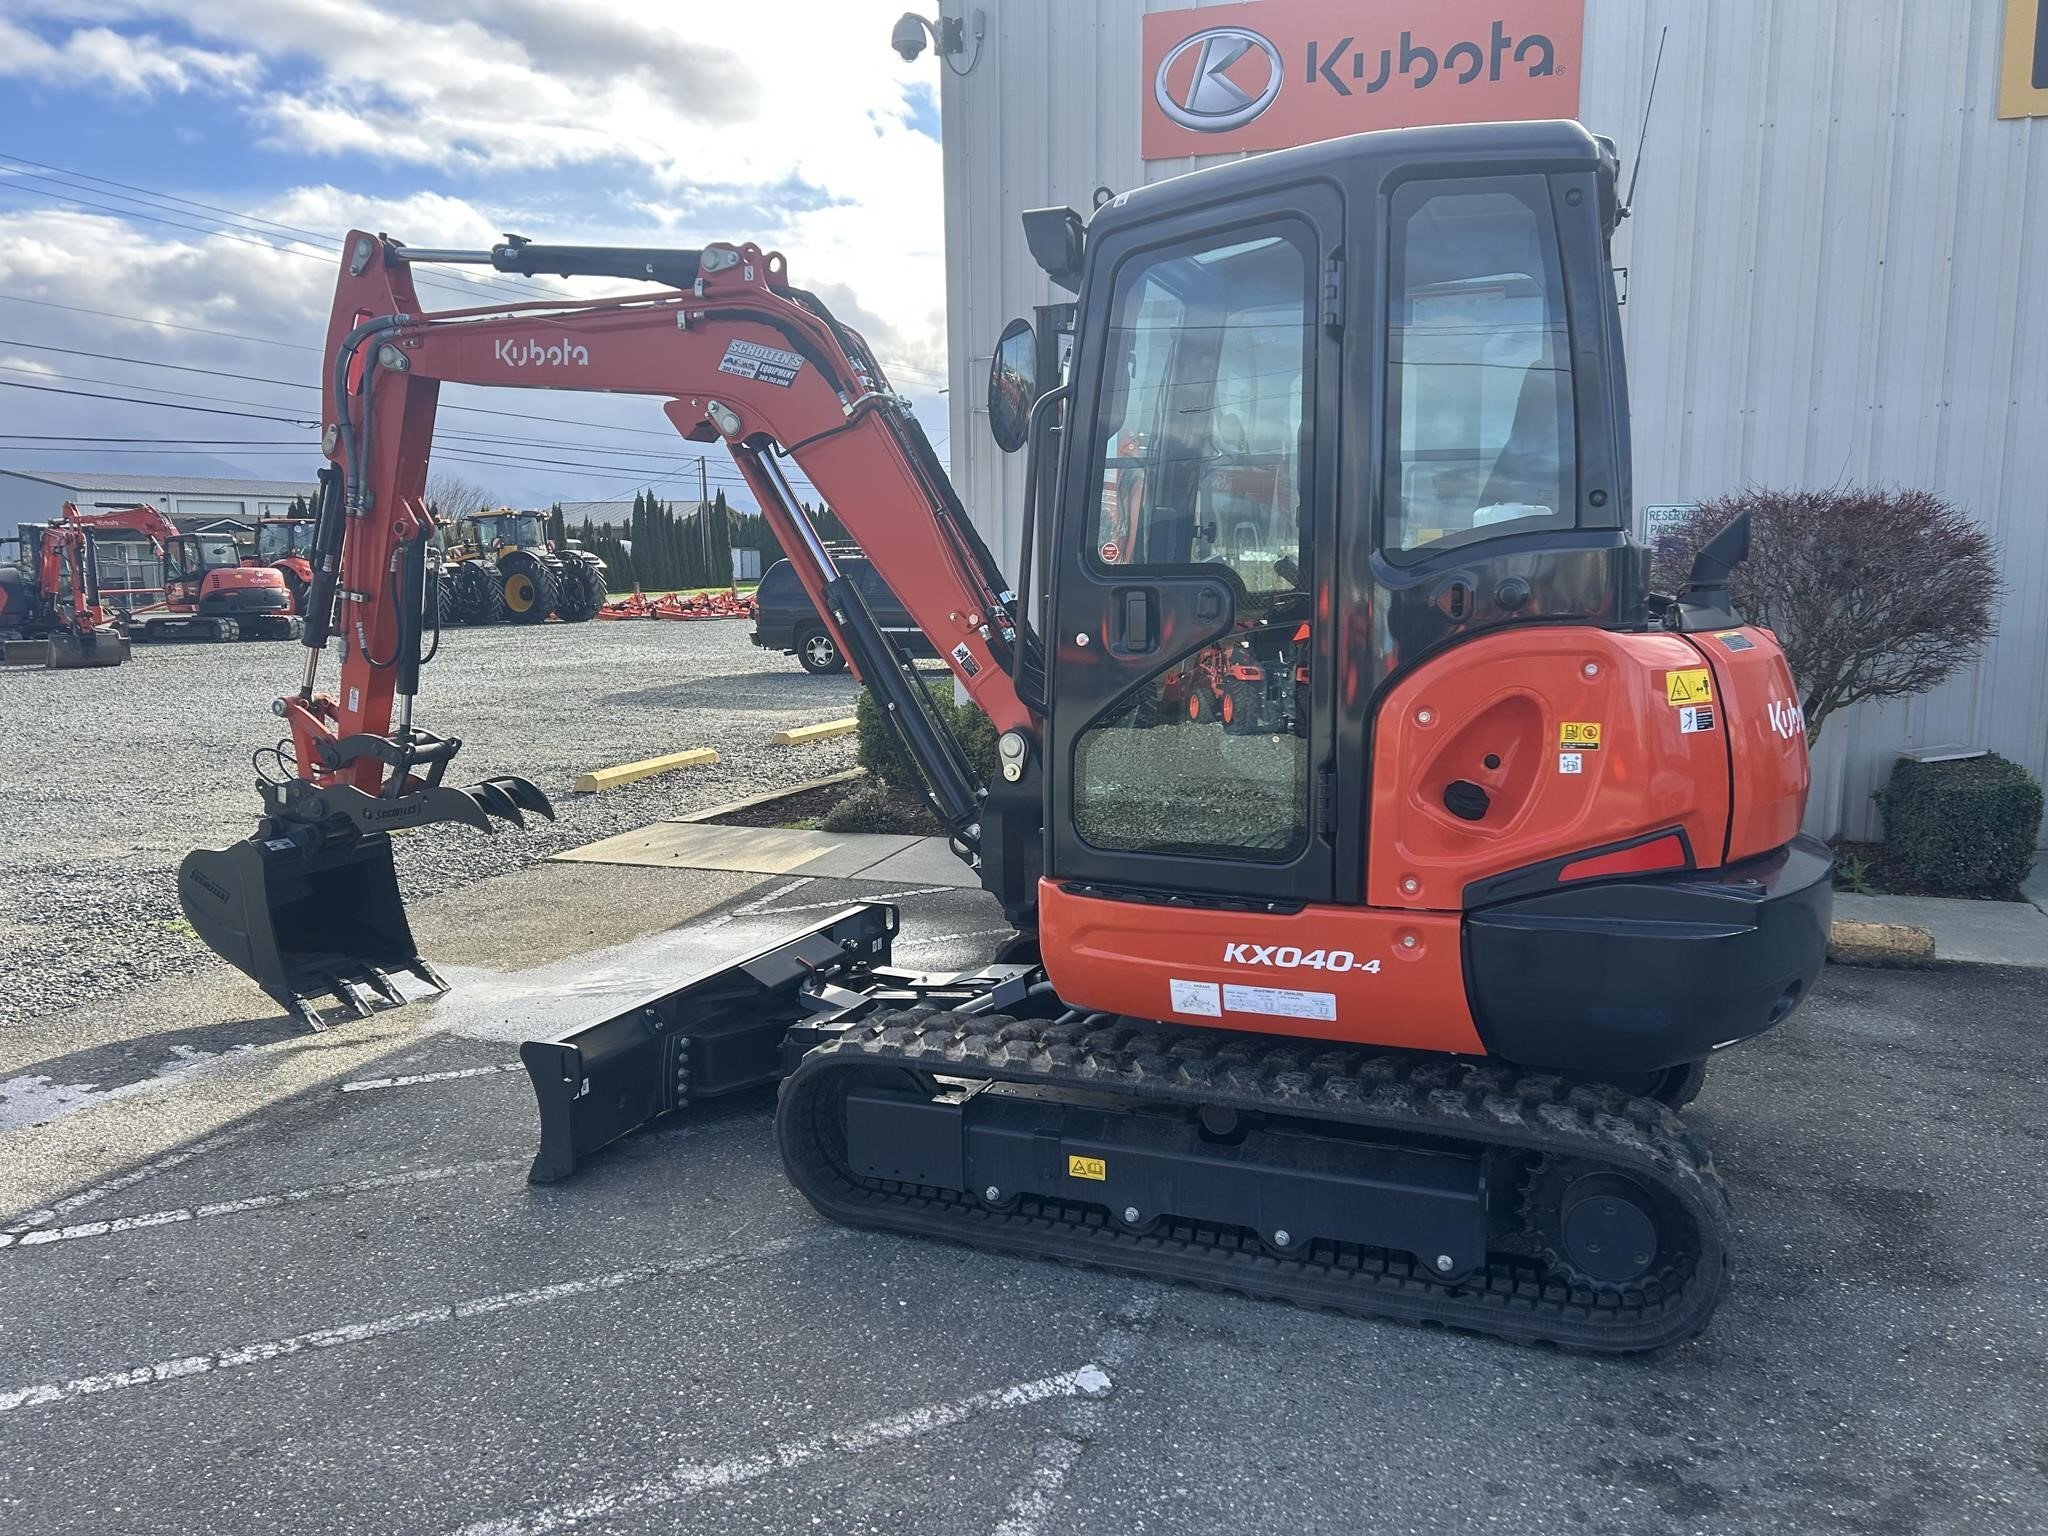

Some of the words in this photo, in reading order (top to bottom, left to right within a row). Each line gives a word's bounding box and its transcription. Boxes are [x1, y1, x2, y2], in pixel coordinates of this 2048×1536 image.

[1306, 21, 1555, 97] Kubota
[494, 338, 588, 366] Kubota
[729, 342, 802, 368] SCHOLTEN'S
[759, 363, 797, 380] EQUIPMENT
[1223, 942, 1381, 974] KX040-4
